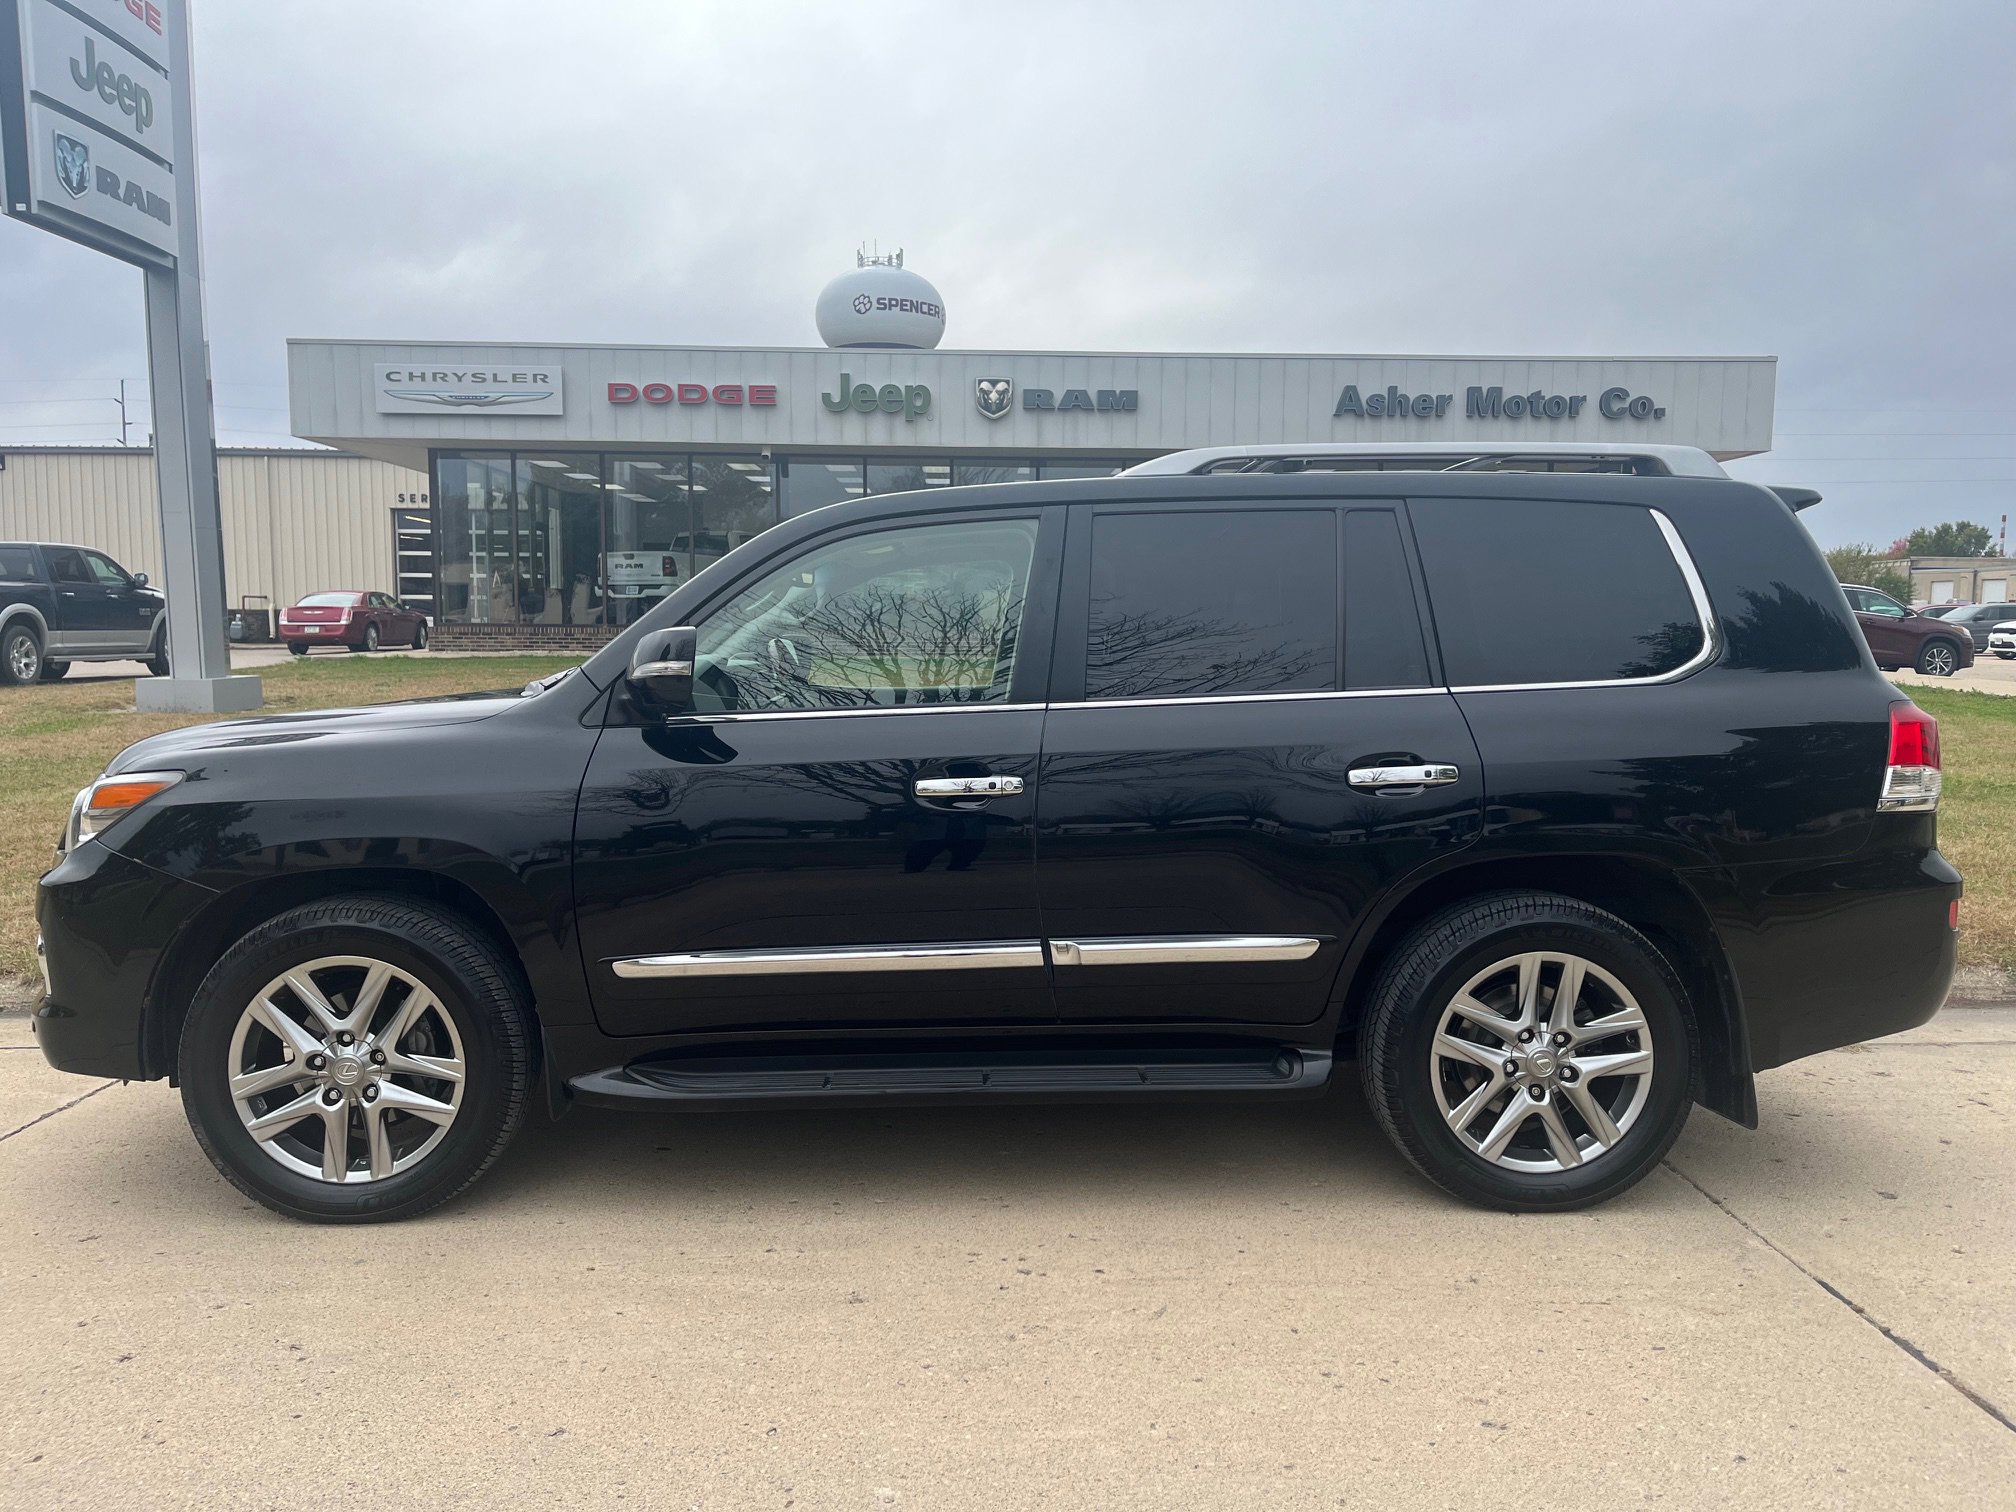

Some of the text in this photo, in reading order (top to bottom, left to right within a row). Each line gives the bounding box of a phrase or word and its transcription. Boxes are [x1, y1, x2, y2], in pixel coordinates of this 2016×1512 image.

[122, 0, 162, 36] GE
[69, 36, 154, 134] Jeep
[95, 165, 171, 226] RAM
[875, 296, 940, 319] SPENCER
[385, 371, 550, 384] CHRYSLER
[607, 382, 777, 406] DODGE
[821, 373, 932, 422] Jeep
[1023, 388, 1139, 411] RAM
[1333, 384, 1667, 420] Asher Motor Co.
[398, 493, 429, 504] SER
